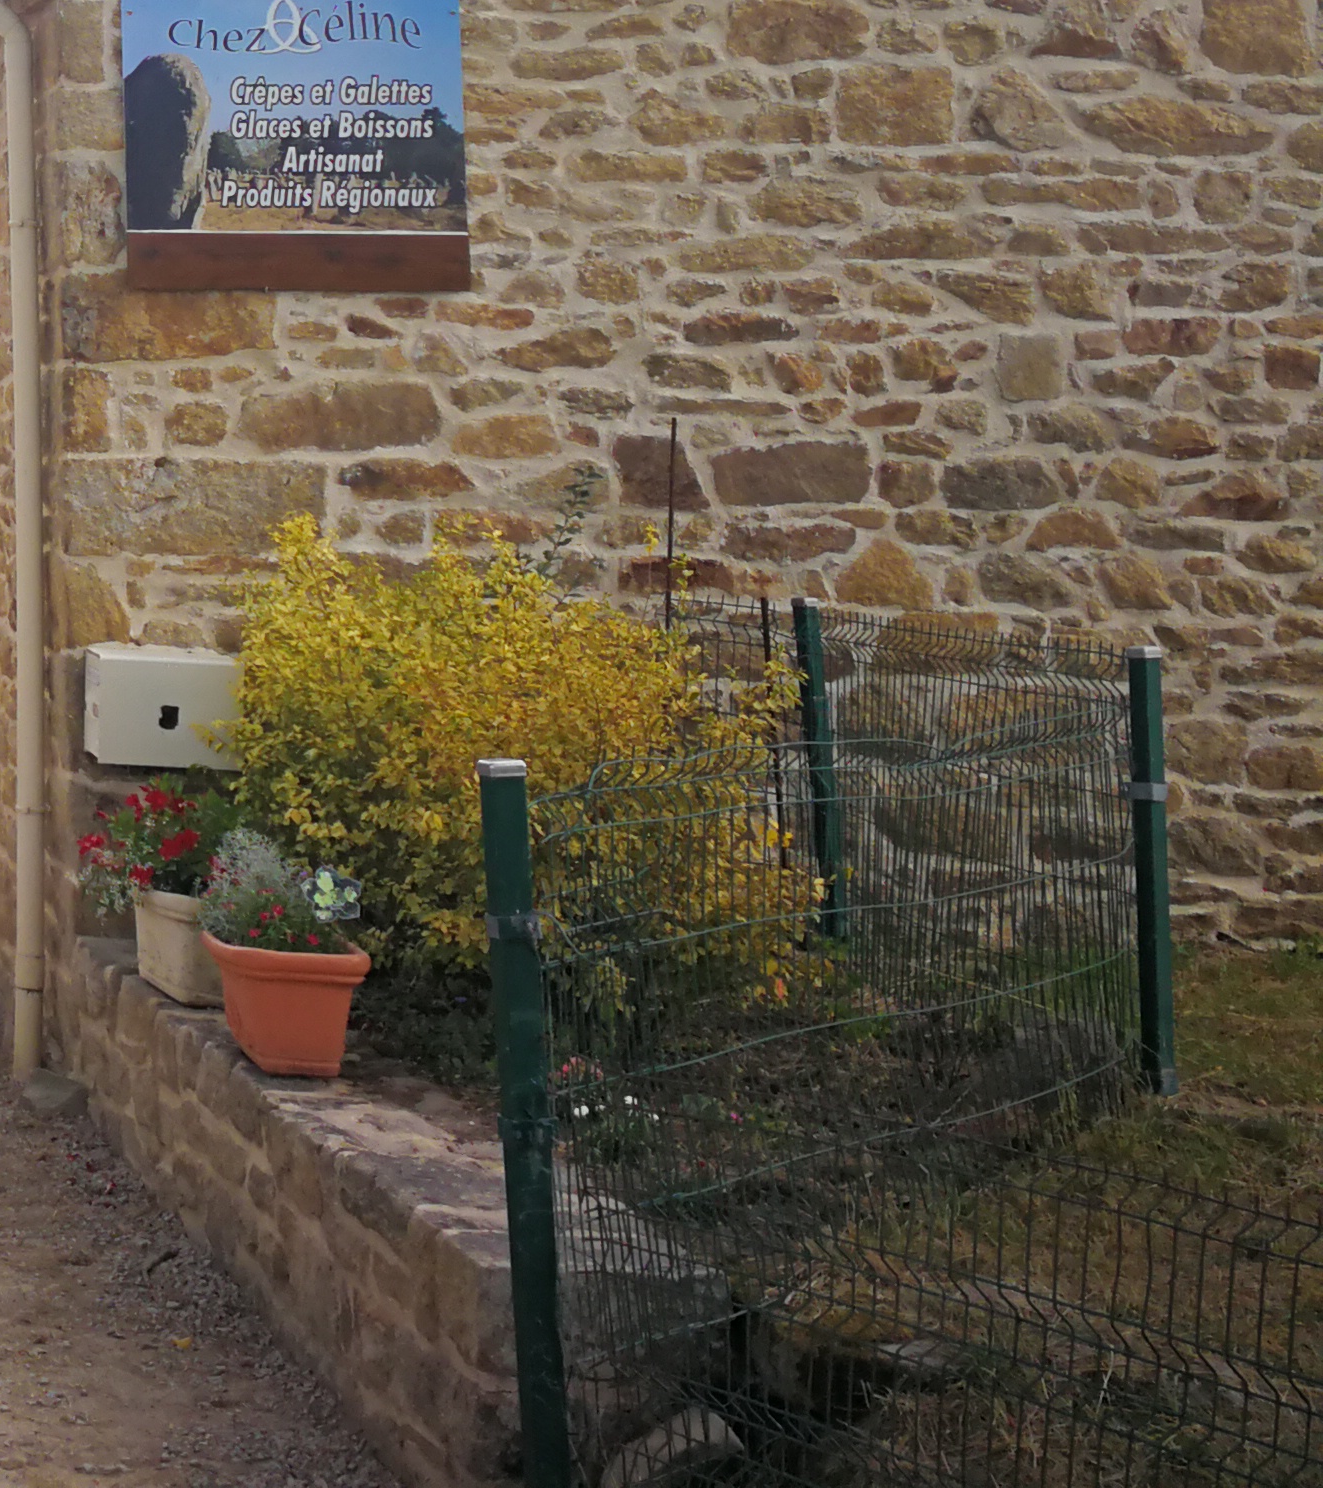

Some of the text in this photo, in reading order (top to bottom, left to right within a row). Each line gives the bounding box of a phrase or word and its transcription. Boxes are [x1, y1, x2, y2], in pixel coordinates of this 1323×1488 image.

[167, 0, 423, 53] Chez Céline
[231, 76, 432, 109] Crêpes et Galettes
[232, 111, 434, 139] Glaces et Boissons
[282, 146, 384, 173] Artisanat
[221, 180, 437, 212] Produits Régionaux
